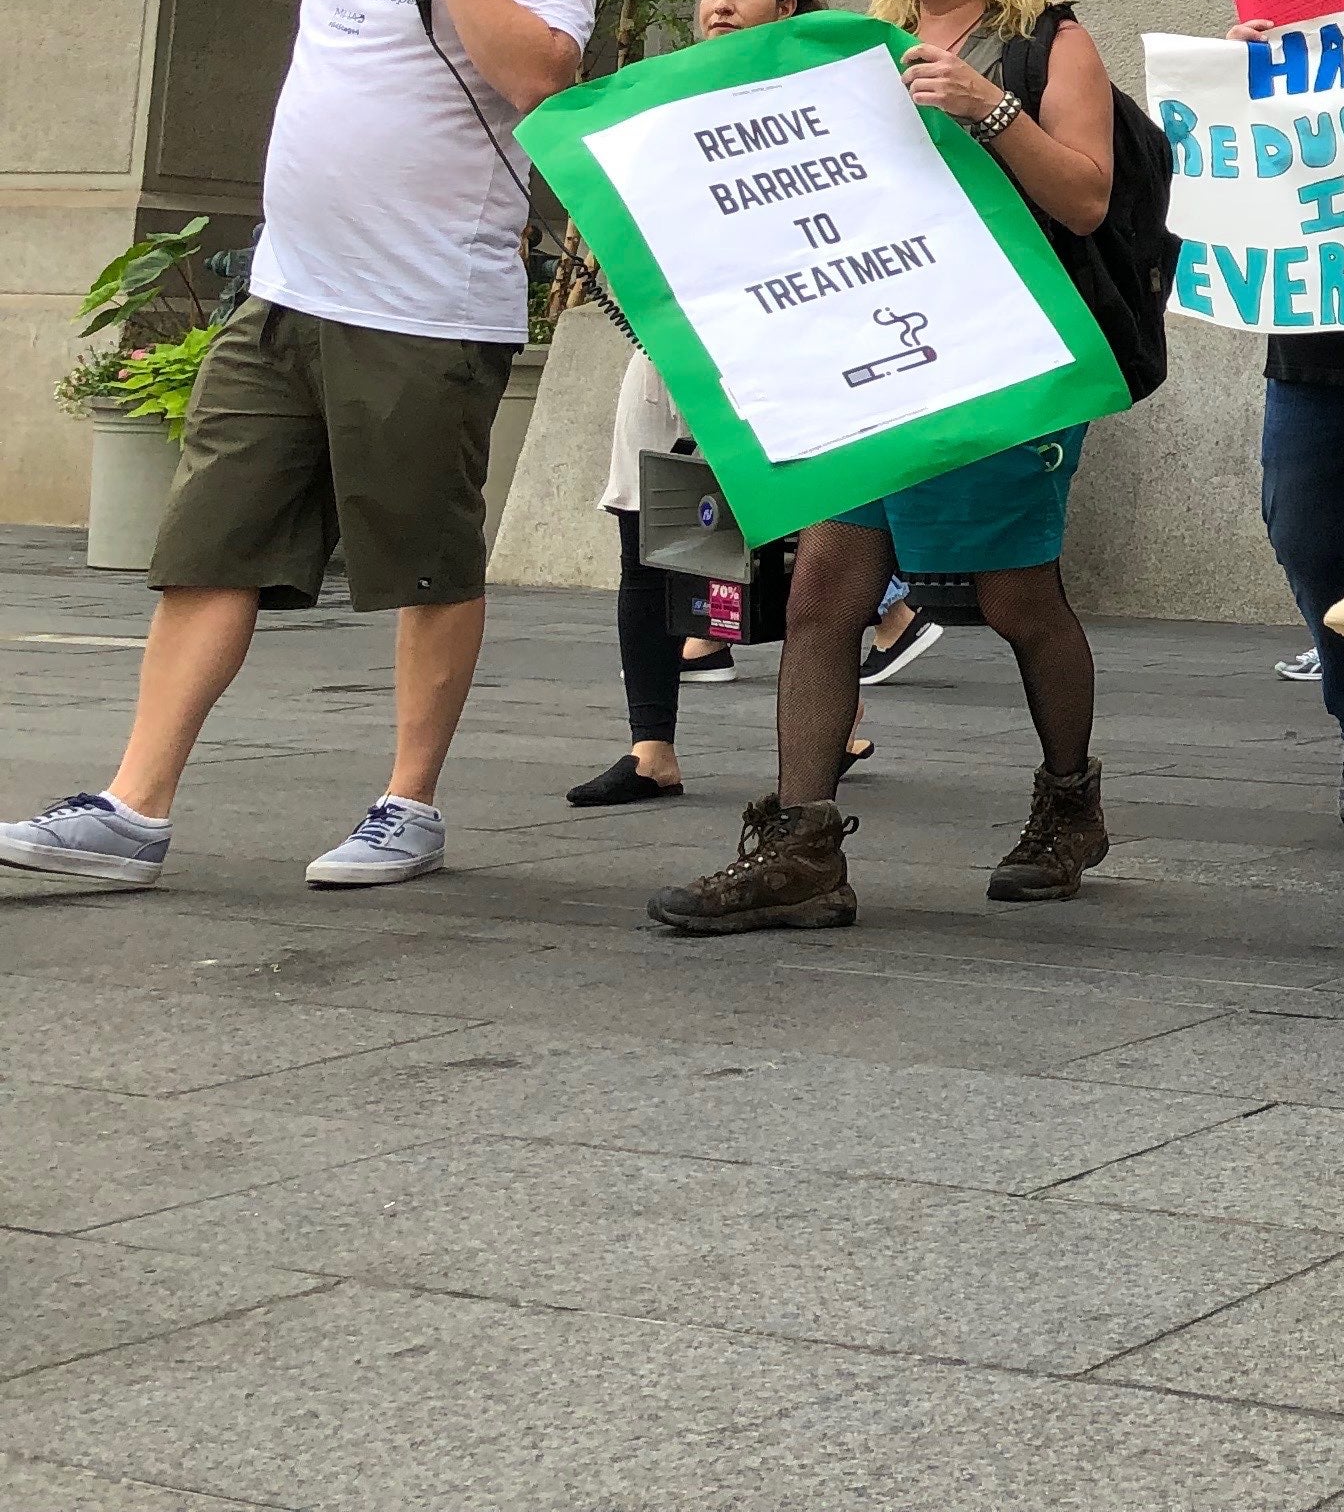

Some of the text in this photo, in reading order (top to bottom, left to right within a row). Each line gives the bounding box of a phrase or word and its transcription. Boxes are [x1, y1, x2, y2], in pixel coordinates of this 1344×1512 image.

[693, 104, 831, 164] REMOVE
[708, 150, 868, 216] BARRIERS
[793, 211, 842, 250] TO
[744, 234, 939, 316] TREATMENT
[711, 583, 740, 600] 70%
